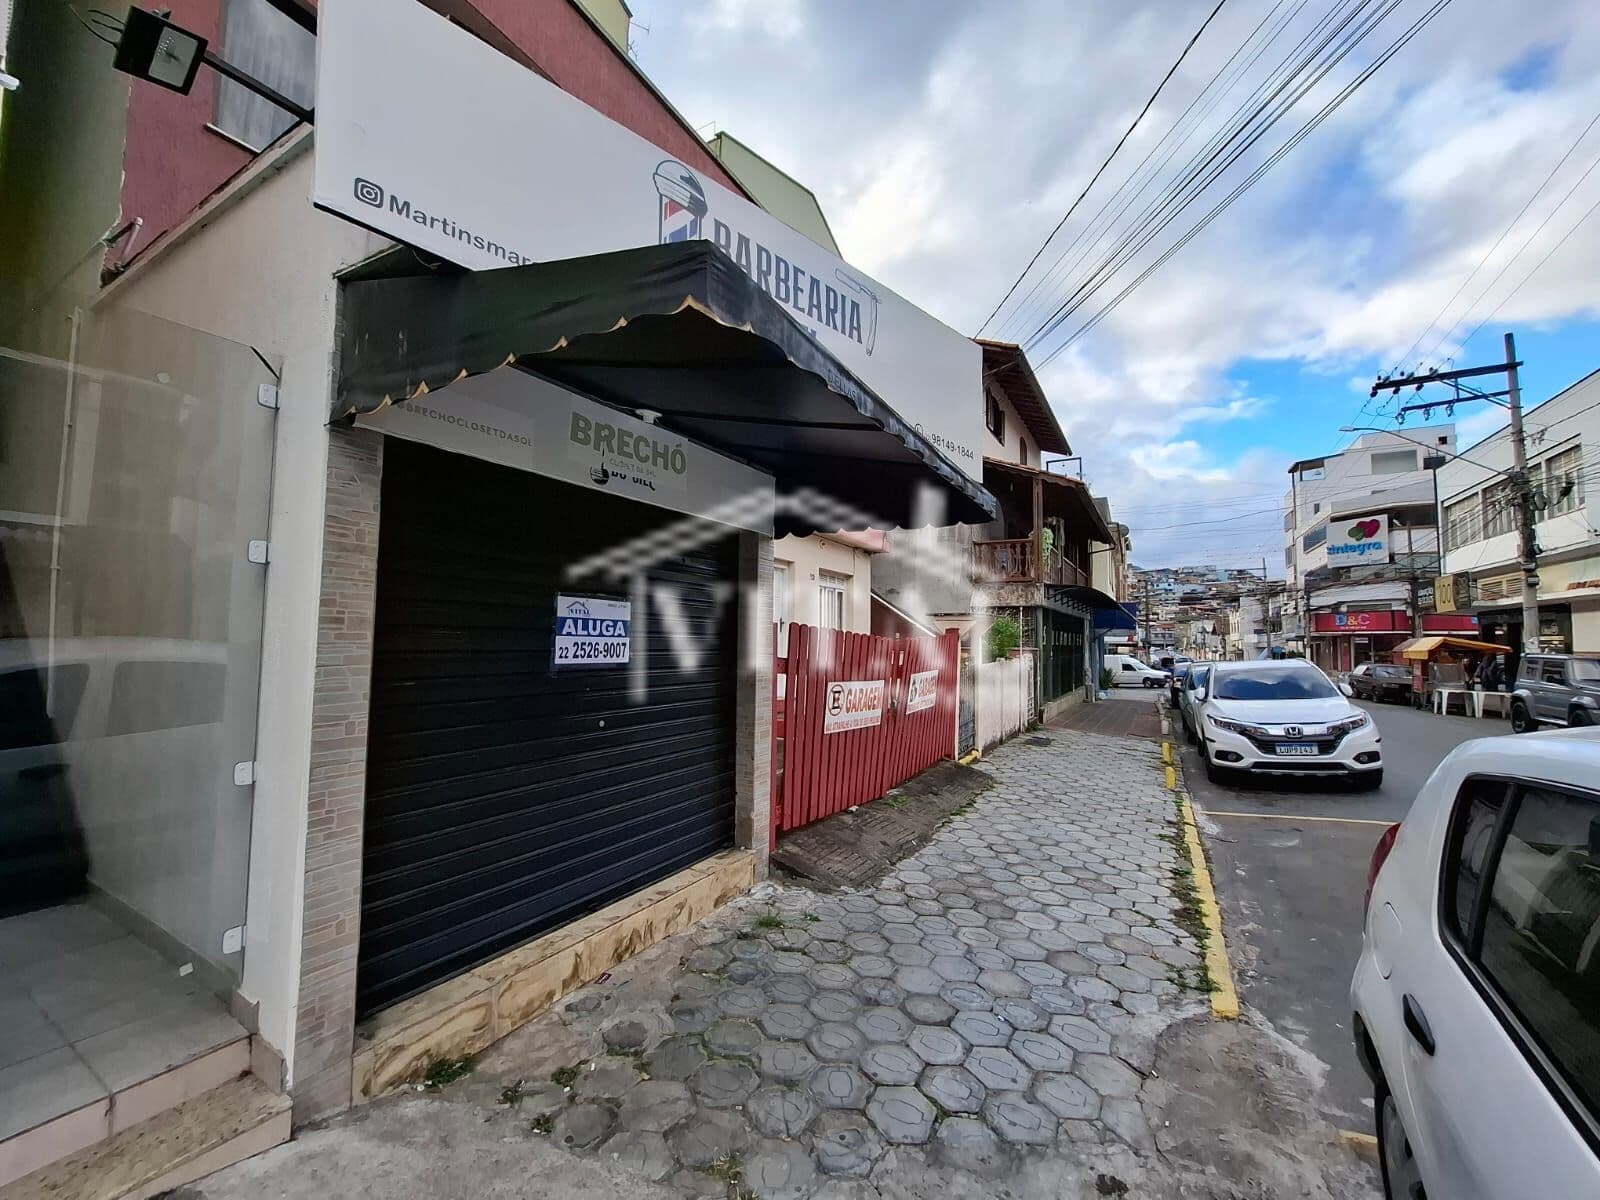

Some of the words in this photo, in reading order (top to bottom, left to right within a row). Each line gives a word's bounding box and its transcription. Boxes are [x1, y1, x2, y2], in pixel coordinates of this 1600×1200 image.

[389, 195, 536, 266] Martinsmar
[714, 218, 863, 344] BARBEARIA
[570, 411, 687, 475] BRECHÓ
[562, 619, 626, 637] ALUGA
[1335, 613, 1370, 626] D&C
[559, 647, 569, 659] 22
[572, 642, 627, 659] 2526-9007
